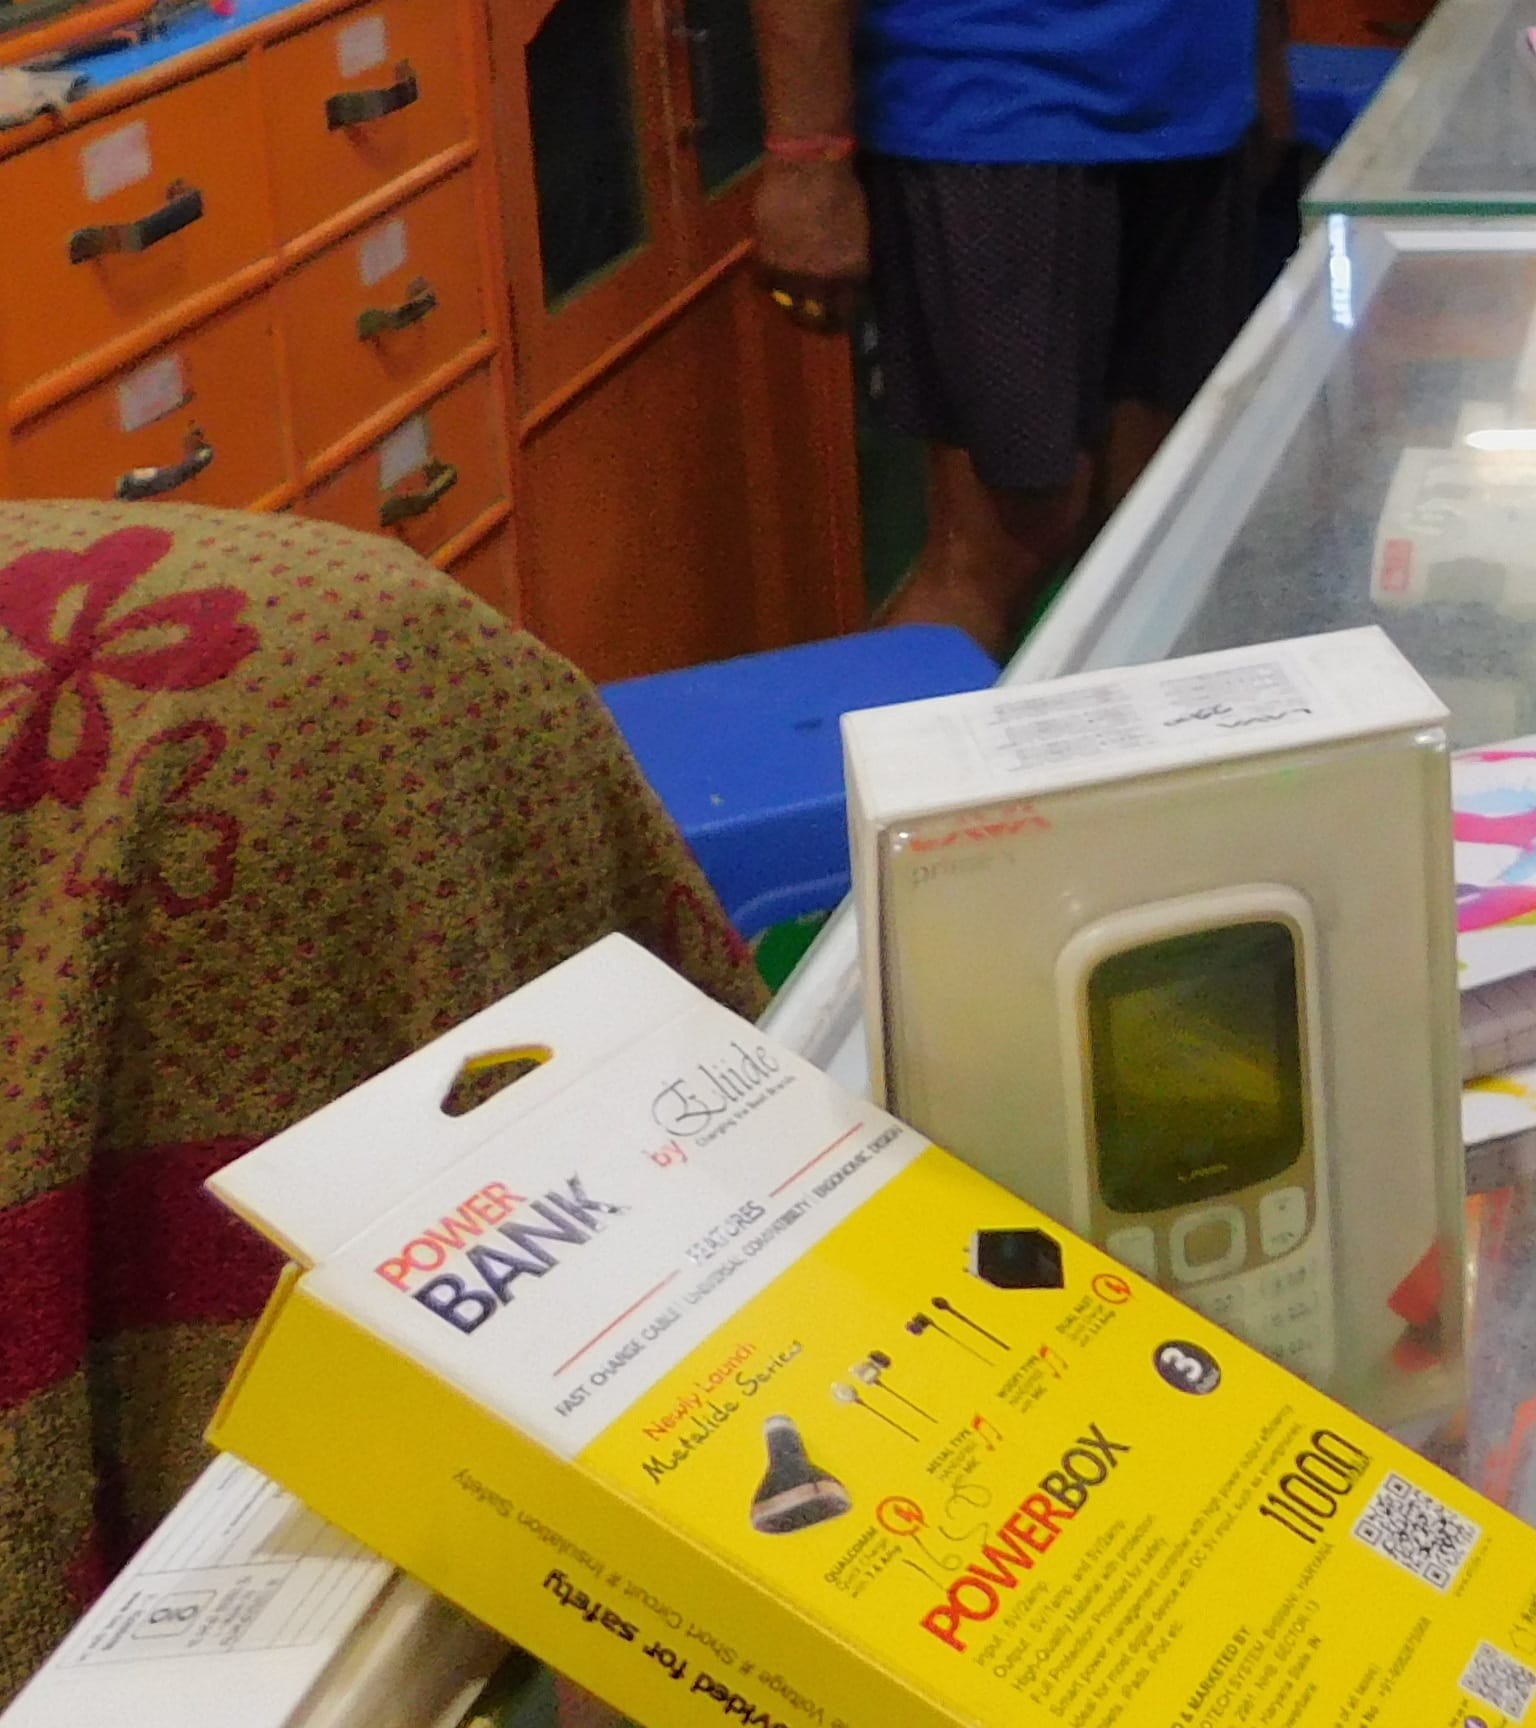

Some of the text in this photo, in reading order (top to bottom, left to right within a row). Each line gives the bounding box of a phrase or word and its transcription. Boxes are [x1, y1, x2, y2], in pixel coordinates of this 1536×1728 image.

[640, 1134, 693, 1172] by
[373, 1178, 526, 1292] POWER
[411, 1172, 629, 1335] BANK
[683, 1200, 767, 1265] FEATURES
[553, 1385, 593, 1415] FAST
[587, 1339, 646, 1386] CHARGE
[640, 1308, 682, 1340] CABLE
[643, 1341, 757, 1440] Newly Launch
[1161, 1346, 1203, 1384] 3
[1260, 1429, 1366, 1546] 11000
[919, 1422, 1130, 1653] POWERBOX
[539, 1566, 642, 1648] safety
[640, 1637, 689, 1681] for
[1187, 1642, 1239, 1709] MARKETED
